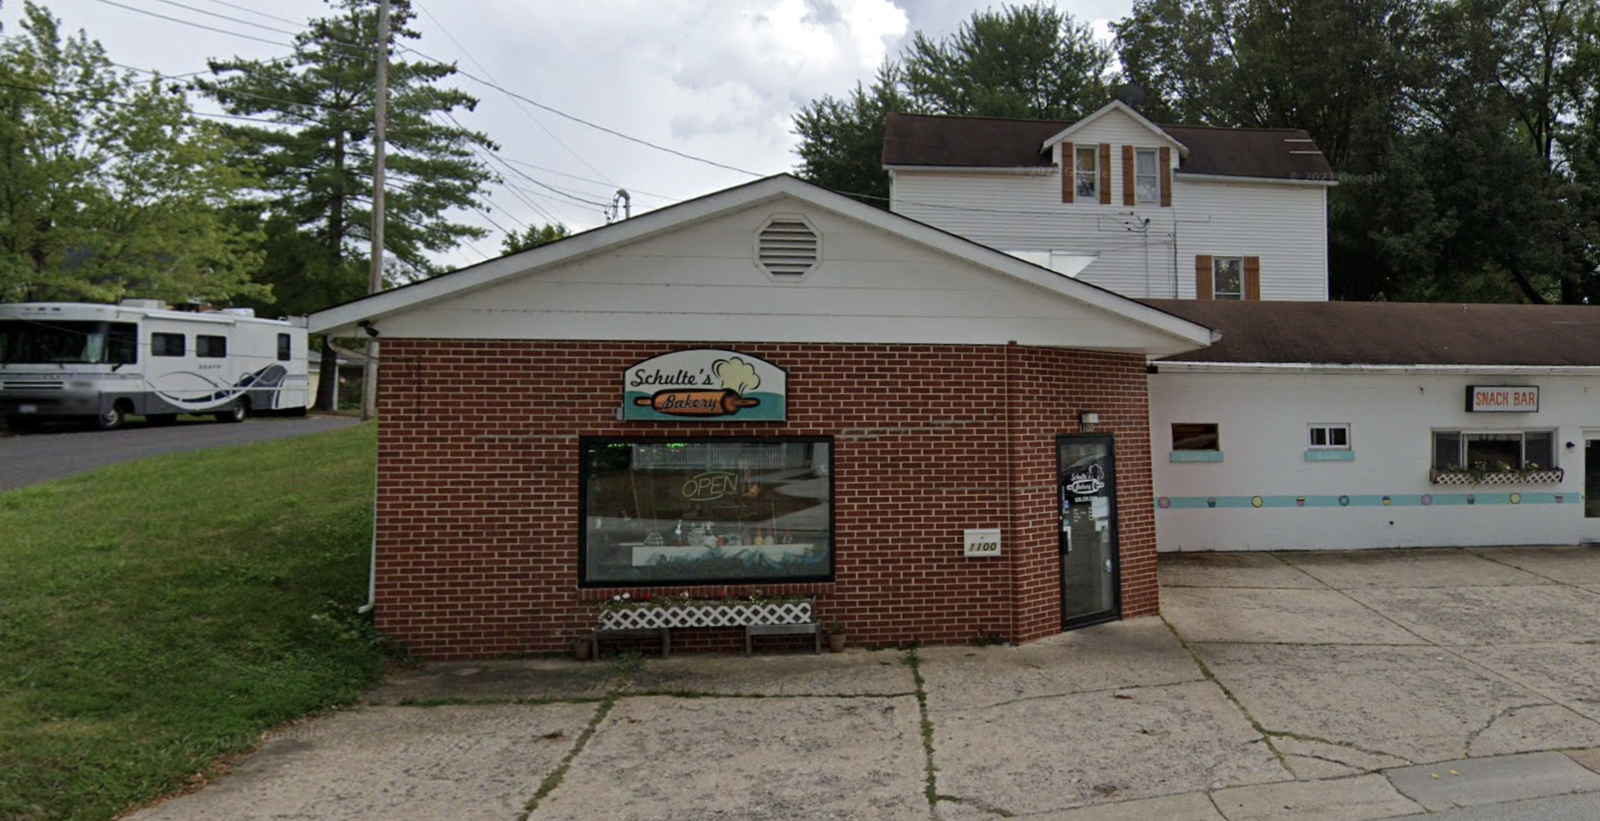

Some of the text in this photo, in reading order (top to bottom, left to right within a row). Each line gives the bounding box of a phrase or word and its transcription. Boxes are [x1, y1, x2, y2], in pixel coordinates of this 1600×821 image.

[630, 368, 713, 387] Schulte's
[662, 394, 718, 411] Bakery
[1475, 391, 1536, 406] SNACK BAR
[682, 474, 739, 498] OPEN
[970, 542, 998, 552] 1100
